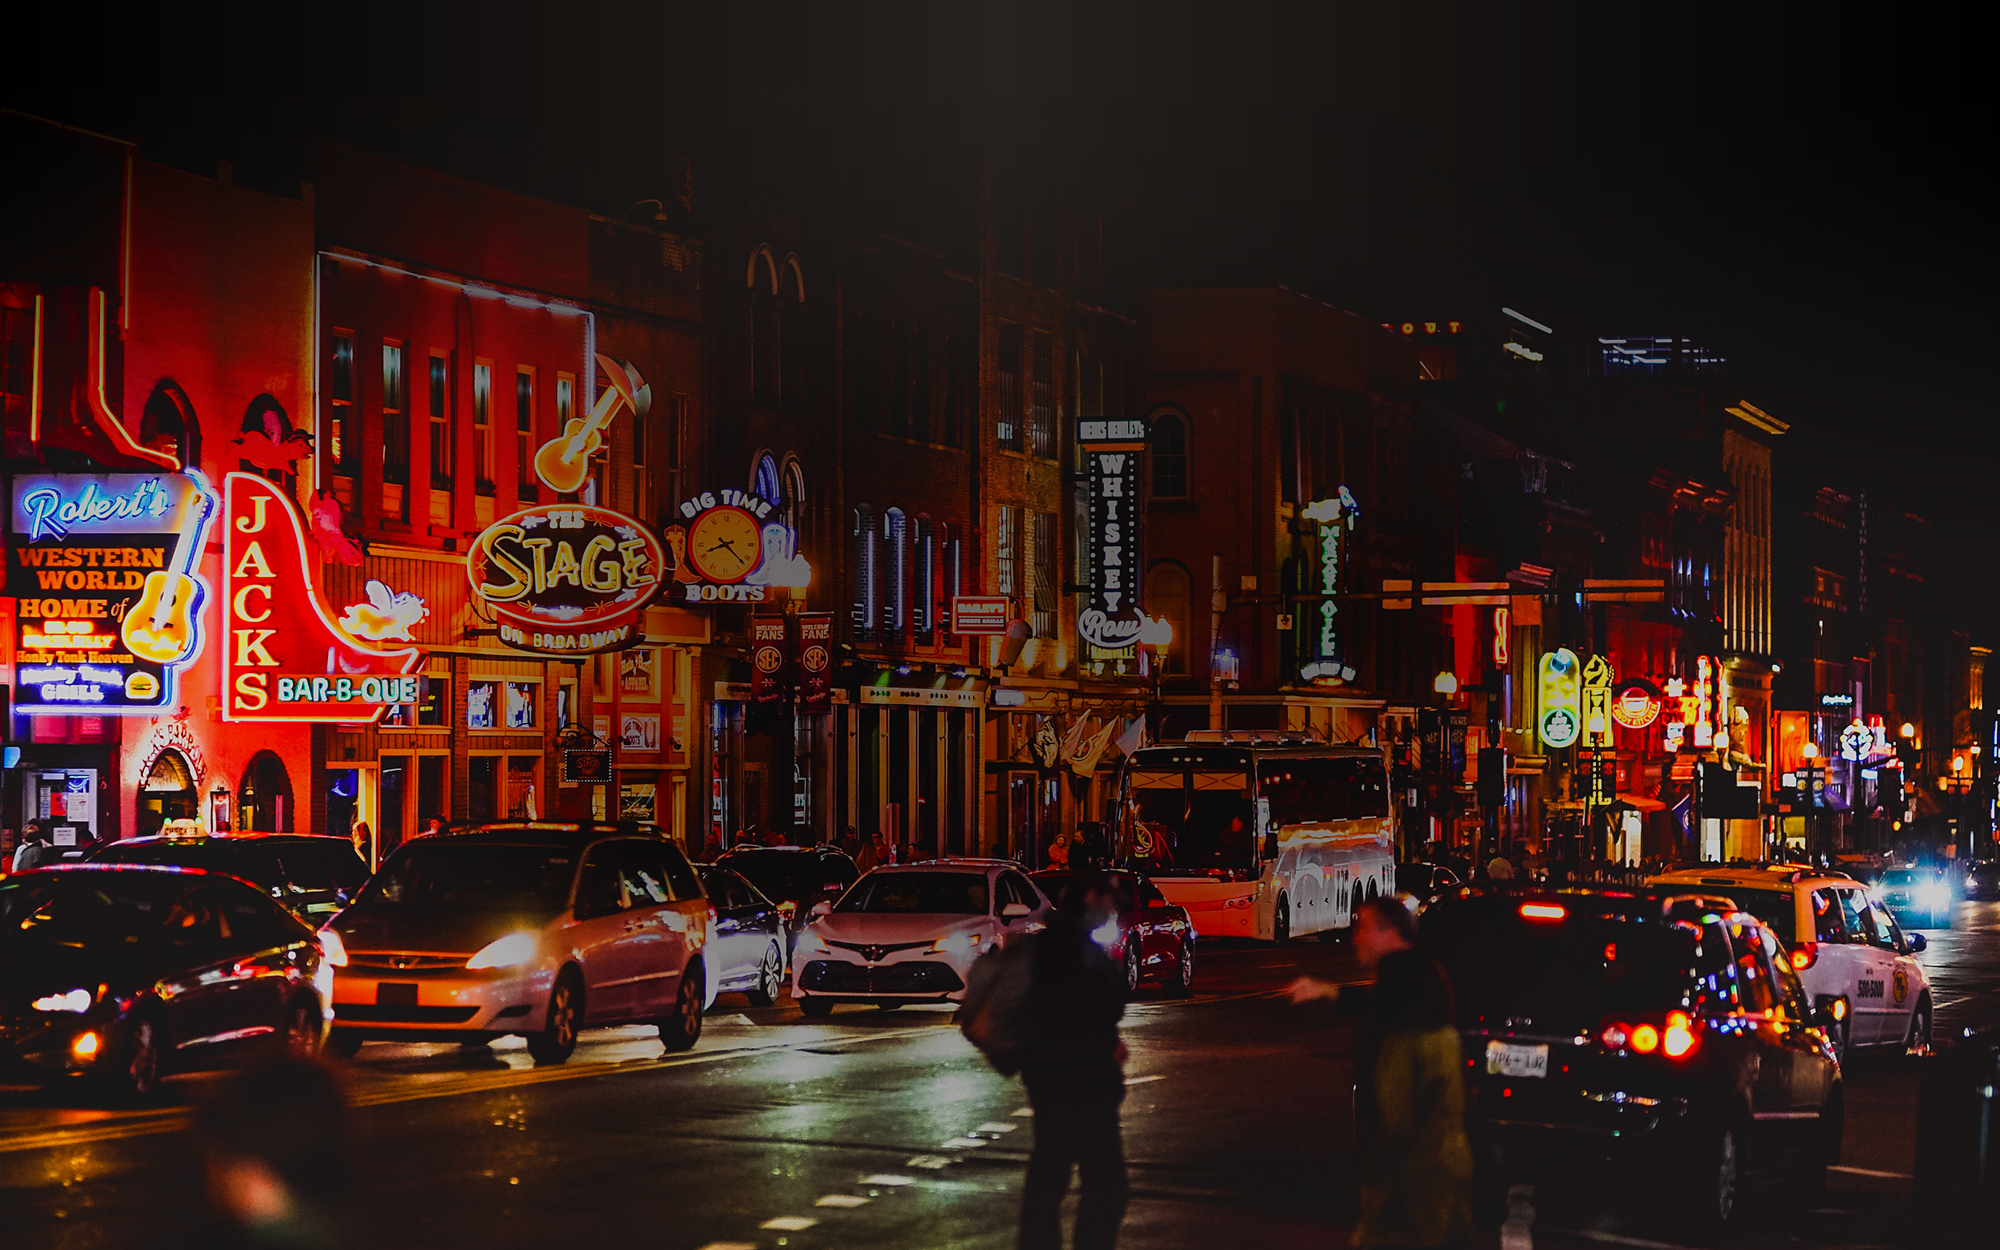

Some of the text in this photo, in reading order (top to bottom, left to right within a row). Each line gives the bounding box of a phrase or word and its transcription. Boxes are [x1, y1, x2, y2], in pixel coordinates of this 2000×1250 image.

[23, 478, 169, 544] Robert's
[680, 489, 773, 519] BIG TIME
[548, 510, 585, 529] THE
[1099, 454, 1125, 612] WHISKEY
[16, 547, 165, 568] WESTERN
[480, 524, 655, 602] STAGE
[36, 570, 144, 590] WORLD
[233, 495, 281, 711] JACKS
[685, 584, 765, 602] BOOTS
[19, 597, 131, 623] HOME of
[500, 625, 630, 650] ON BROADWAY
[755, 631, 784, 640] FANS
[802, 629, 830, 640] FANS
[1081, 608, 1142, 647] Row
[16, 650, 134, 666] Honky Tonk Heaven
[758, 649, 779, 671] SEC
[806, 648, 825, 670] SEC
[1091, 645, 1135, 660] NASHVILLE
[278, 677, 418, 703] BAR-B-QUE
[1613, 703, 1658, 726] CANDY KITCHEN
